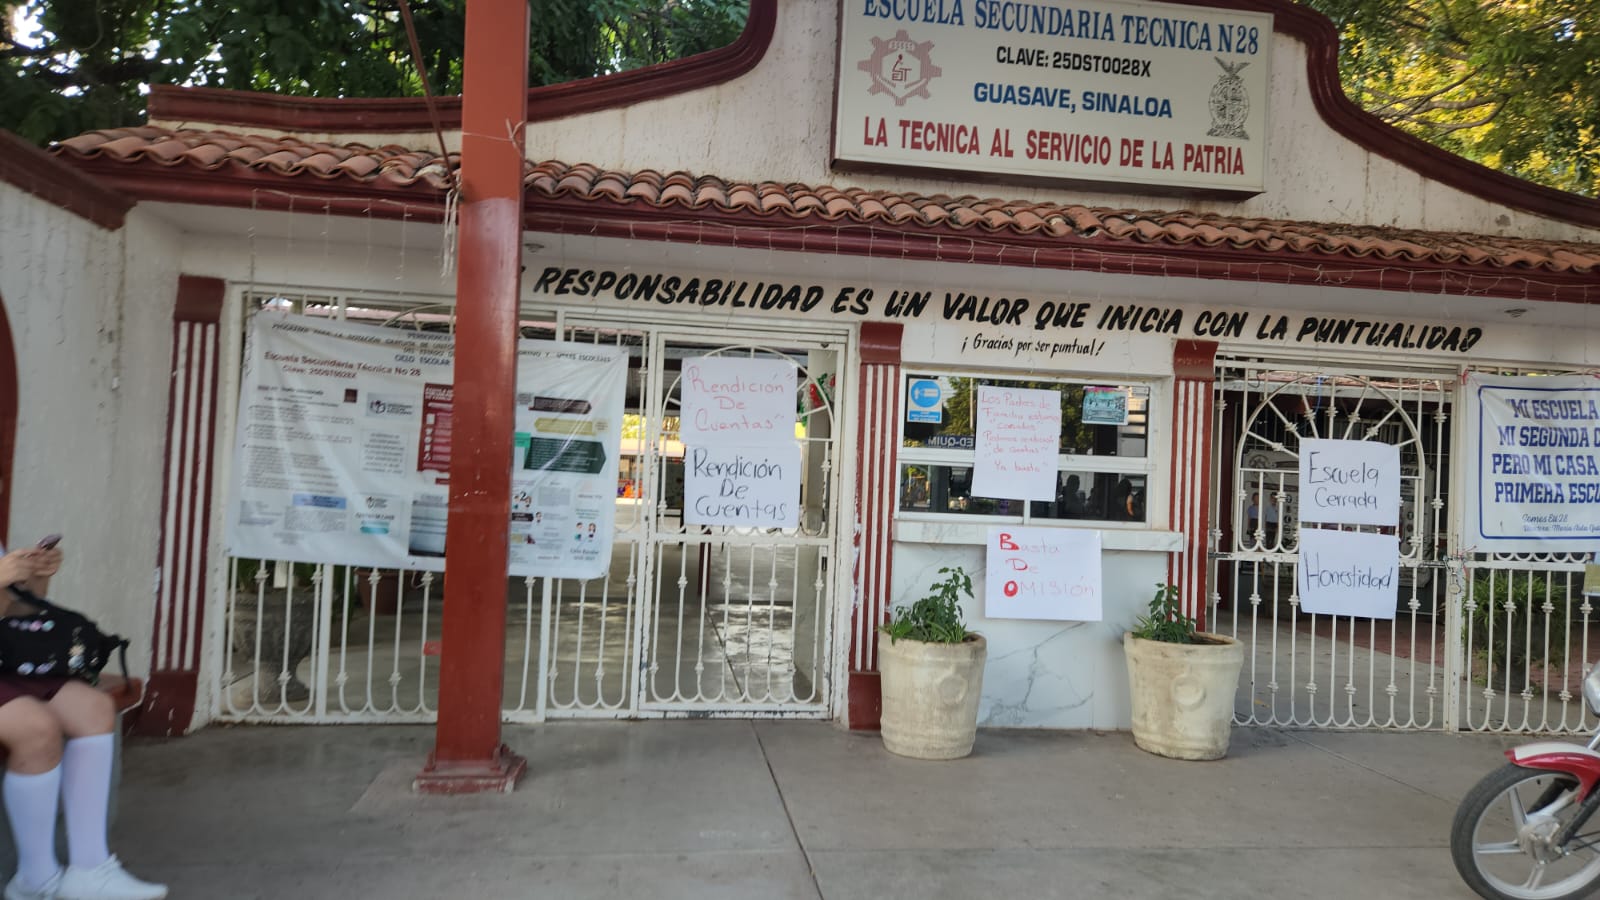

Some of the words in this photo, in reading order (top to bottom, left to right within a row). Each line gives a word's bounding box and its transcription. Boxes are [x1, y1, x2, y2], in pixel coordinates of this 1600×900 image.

[863, 0, 965, 26] ESCUELA
[974, 0, 1115, 41] SECUNDARIA
[1120, 15, 1212, 52] TECNICA
[996, 46, 1049, 68] CLAVE:
[1053, 51, 1152, 78] 25DST0028X
[973, 82, 1076, 118] GUASAVE,
[1081, 91, 1173, 123] SINALOA
[863, 116, 889, 147] LA
[899, 119, 980, 155] TECNICA
[990, 128, 1015, 158] AL
[1025, 129, 1112, 165] SERVICIO
[1119, 138, 1145, 168] DE
[1151, 141, 1175, 170] LA
[1183, 143, 1245, 175] PATRIA
[533, 266, 824, 313] RESPONSABILIDAD
[831, 287, 874, 315] ES
[884, 290, 932, 318] UN
[943, 292, 1030, 325] VALOR
[1035, 301, 1091, 331] QUE
[1096, 304, 1185, 335] INICIA
[1193, 310, 1249, 338] CON
[1256, 314, 1288, 341] LA
[1295, 316, 1483, 353] PUNTUALIDAD
[1017, 341, 1033, 358] por
[1035, 340, 1052, 353] ser
[713, 395, 746, 410] De
[1533, 399, 1599, 420] ESCUELA
[1498, 426, 1516, 446] MI
[1519, 426, 1589, 448] SEGUNDA
[693, 447, 782, 480] Rendición
[1308, 451, 1379, 489] Escuela
[1491, 454, 1530, 475] PERO
[1533, 454, 1553, 475] MI
[1556, 455, 1599, 476] CASA
[720, 478, 749, 500] De
[1314, 486, 1377, 510] Cerrada
[1494, 482, 1565, 504] PRIMERA
[695, 495, 787, 521] Cuentas
[999, 533, 1061, 554] Basta
[1004, 558, 1040, 574] De
[1303, 551, 1393, 592] Honestidad
